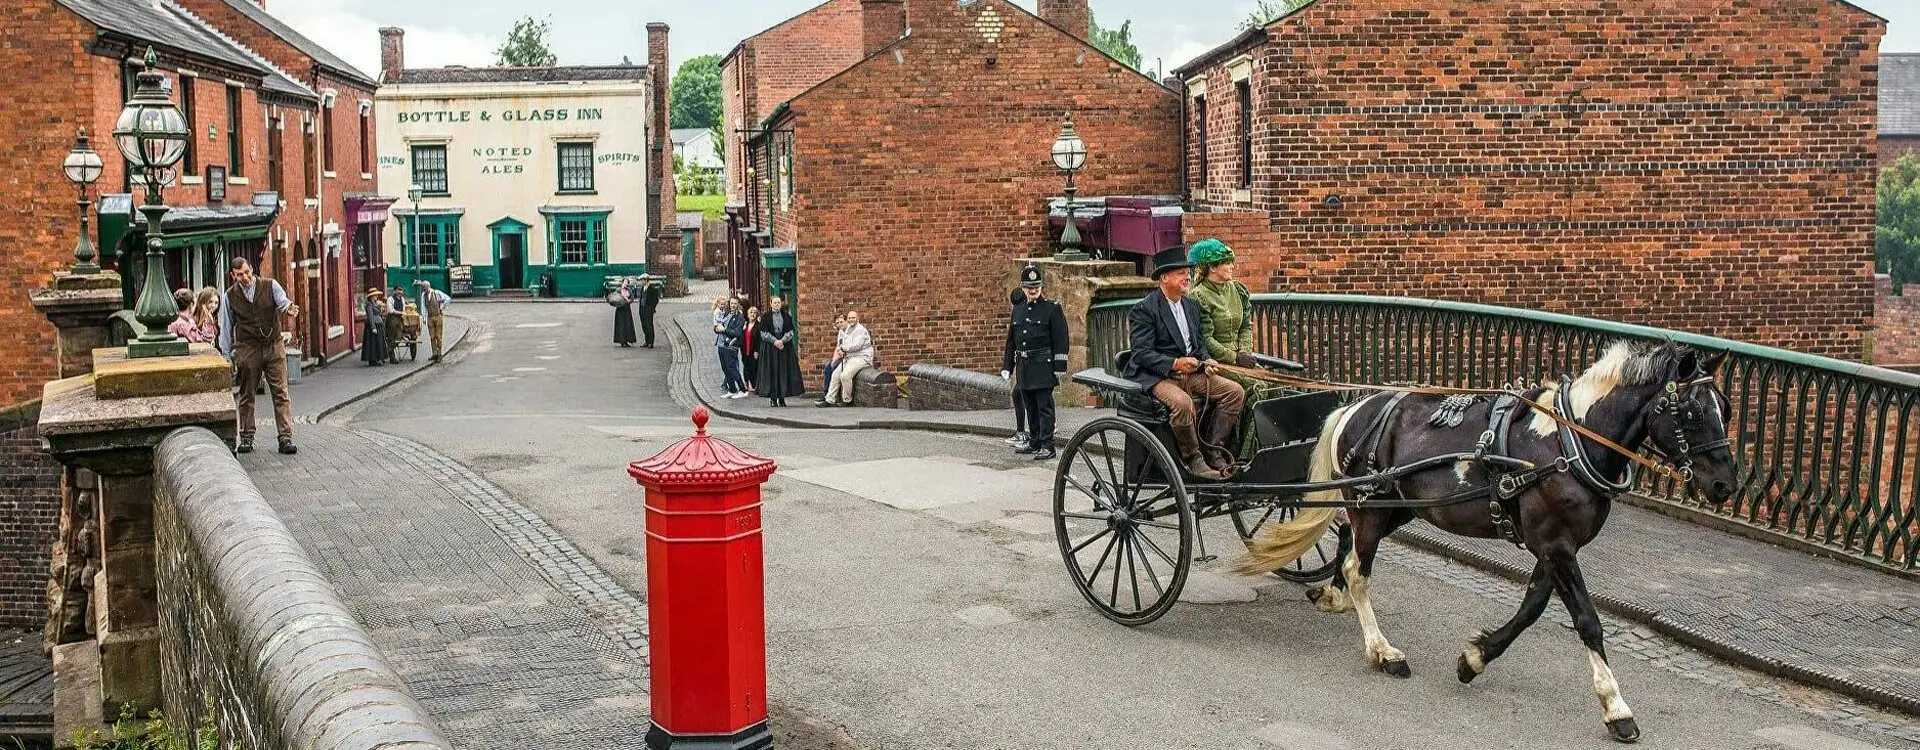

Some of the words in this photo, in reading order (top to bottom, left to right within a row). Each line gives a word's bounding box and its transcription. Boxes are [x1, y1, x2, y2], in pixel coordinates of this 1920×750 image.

[398, 110, 470, 123] BOTTLE
[480, 110, 492, 121] &
[502, 108, 568, 121] GLASS
[577, 108, 602, 120] INN
[473, 147, 532, 156] NOTED
[377, 155, 405, 165] INES
[598, 152, 640, 164] SPIRITS
[482, 165, 523, 174] ALES
